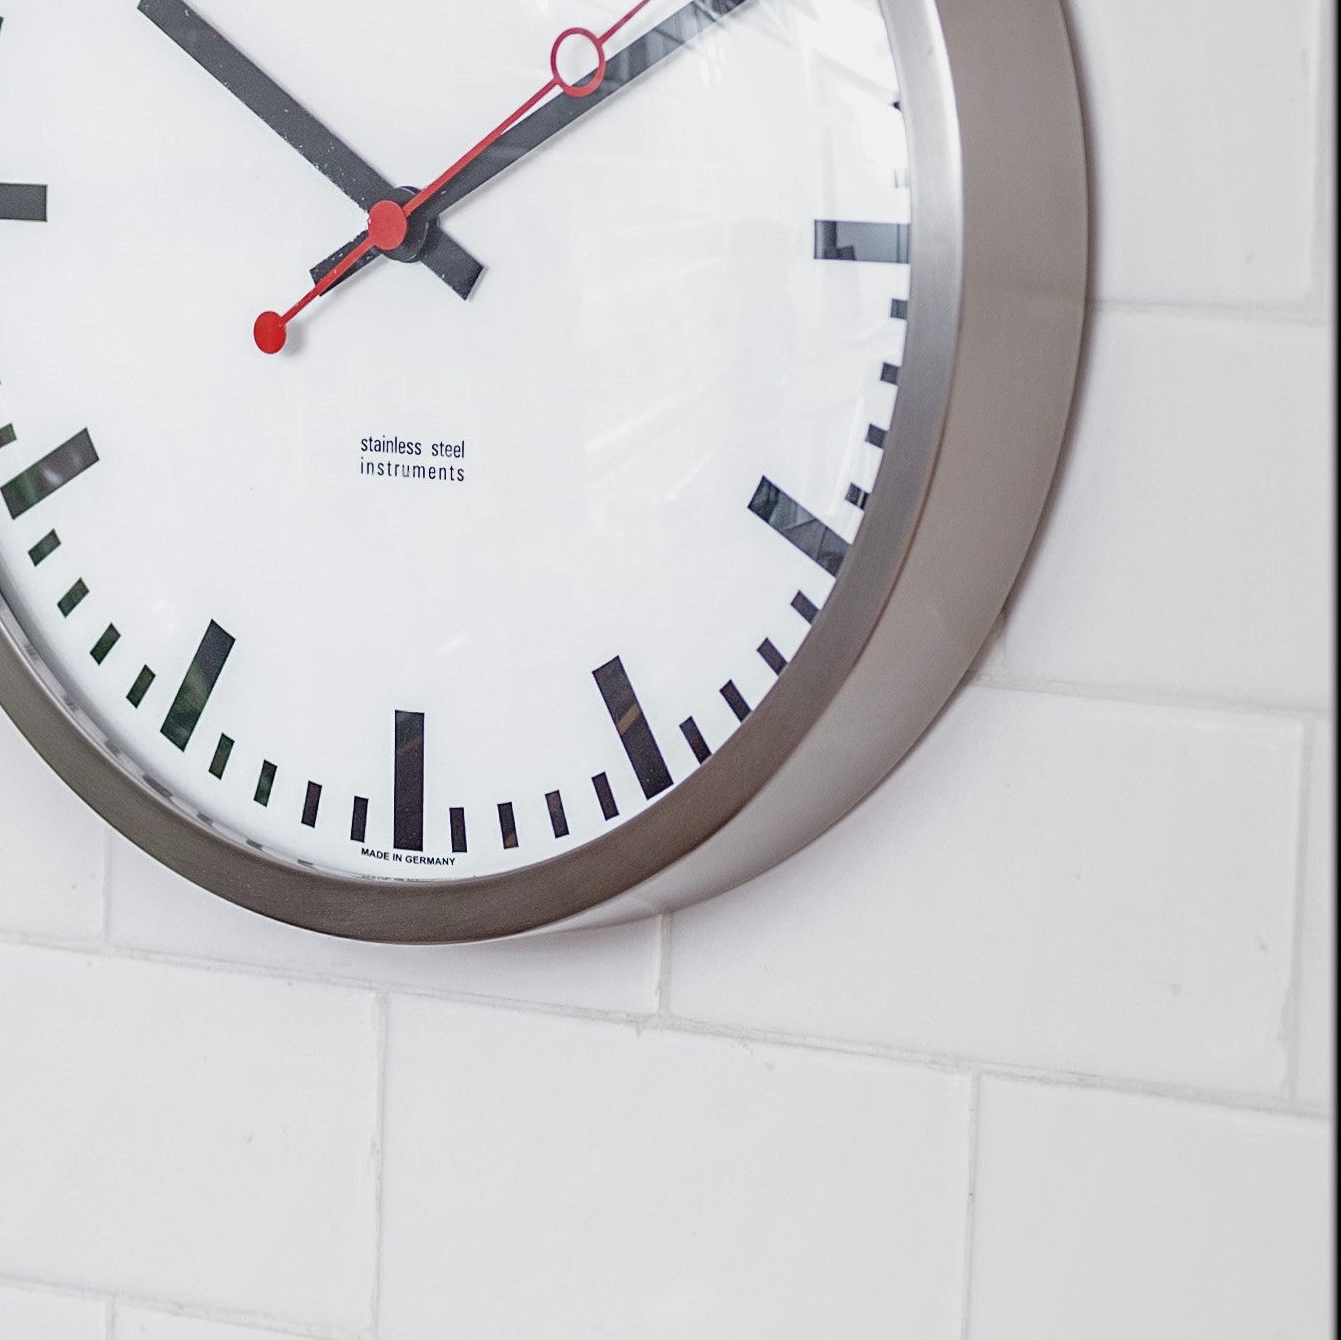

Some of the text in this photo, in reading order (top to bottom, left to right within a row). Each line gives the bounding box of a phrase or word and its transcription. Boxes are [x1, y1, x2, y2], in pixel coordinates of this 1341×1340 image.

[360, 434, 465, 459] stainless steel
[360, 456, 465, 482] instruments
[361, 847, 456, 866] MADE IN GERMANY
